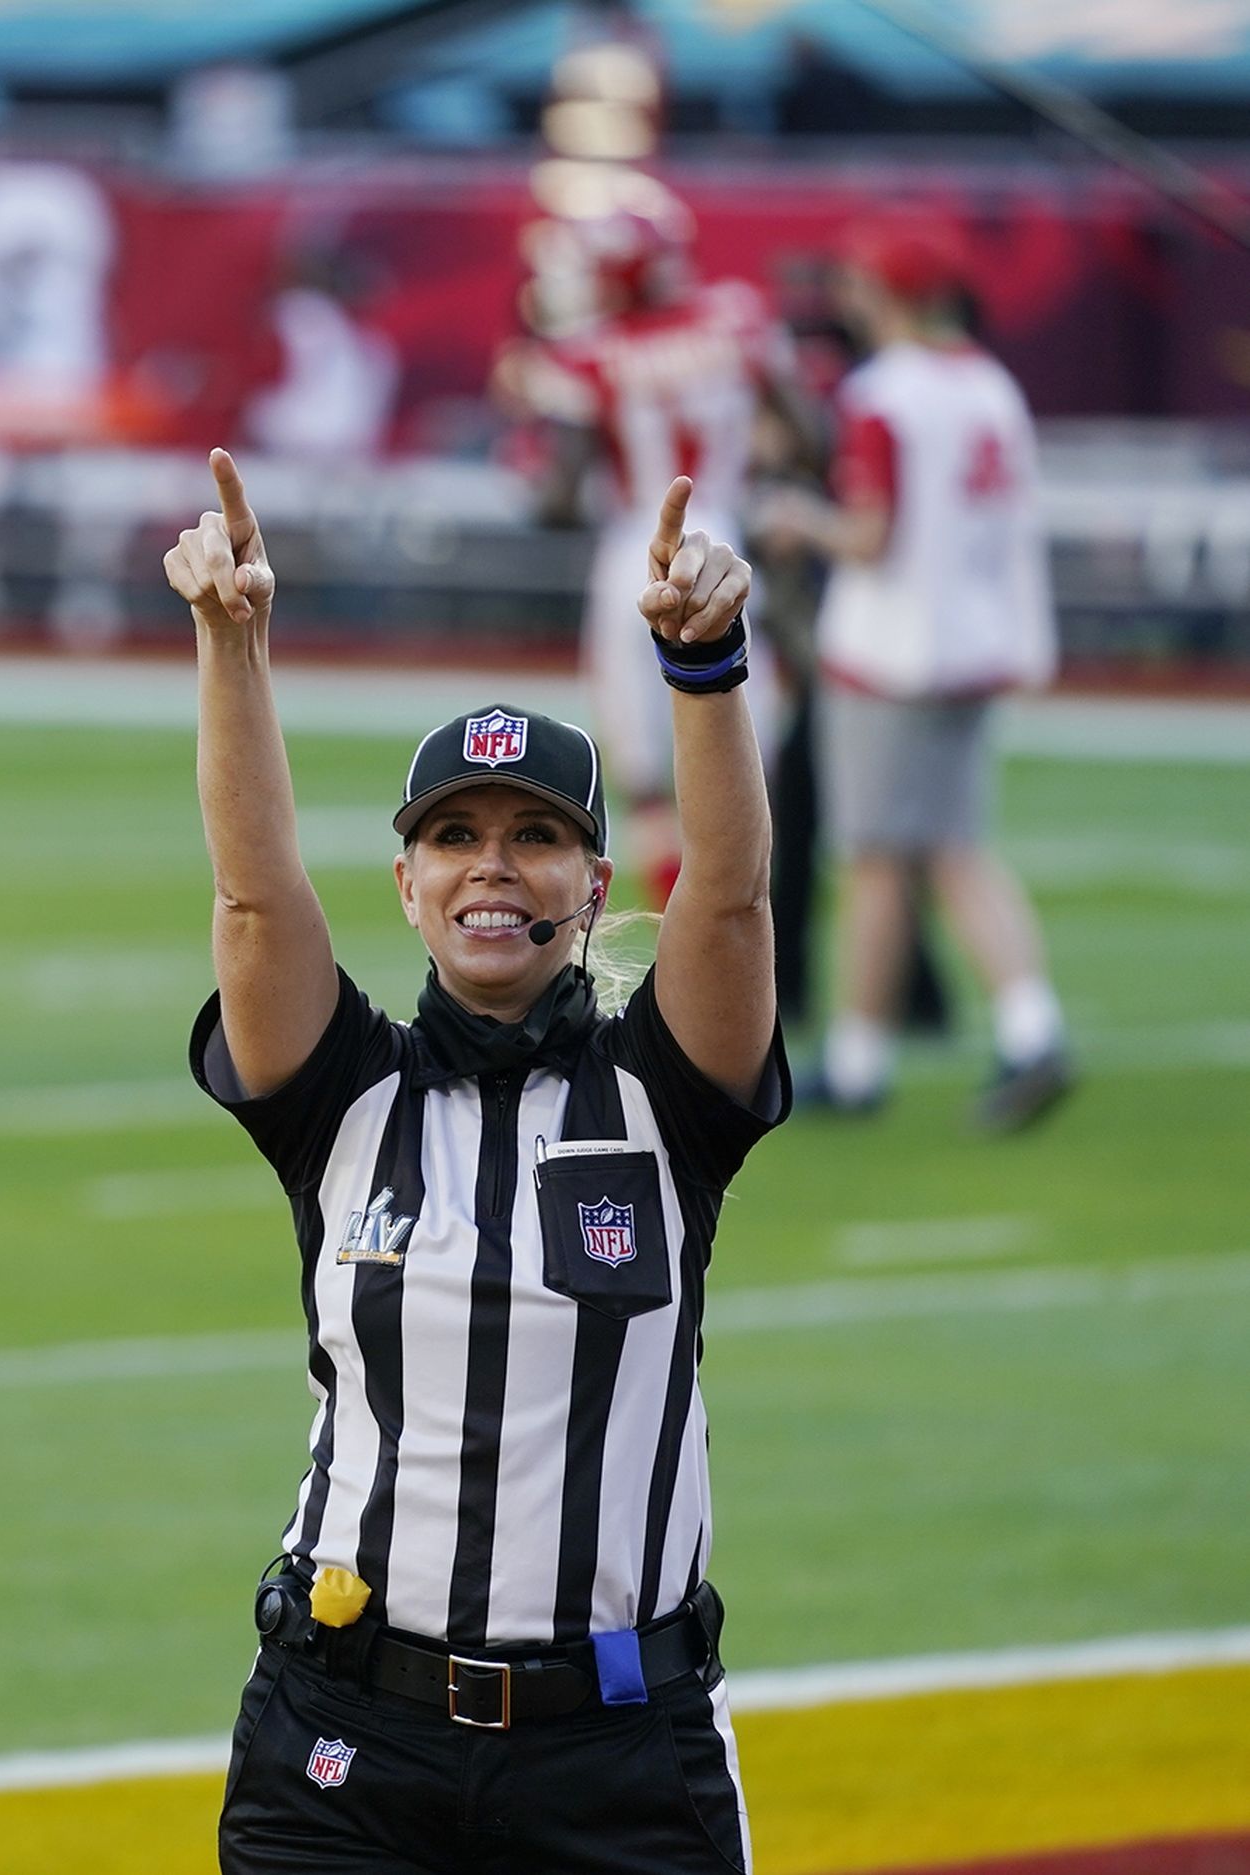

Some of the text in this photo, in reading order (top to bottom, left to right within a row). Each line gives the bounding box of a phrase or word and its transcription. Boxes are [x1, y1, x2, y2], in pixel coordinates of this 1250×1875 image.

[471, 732, 518, 758] NFL
[588, 1228, 631, 1258] NFL
[312, 1755, 342, 1780] NFL
